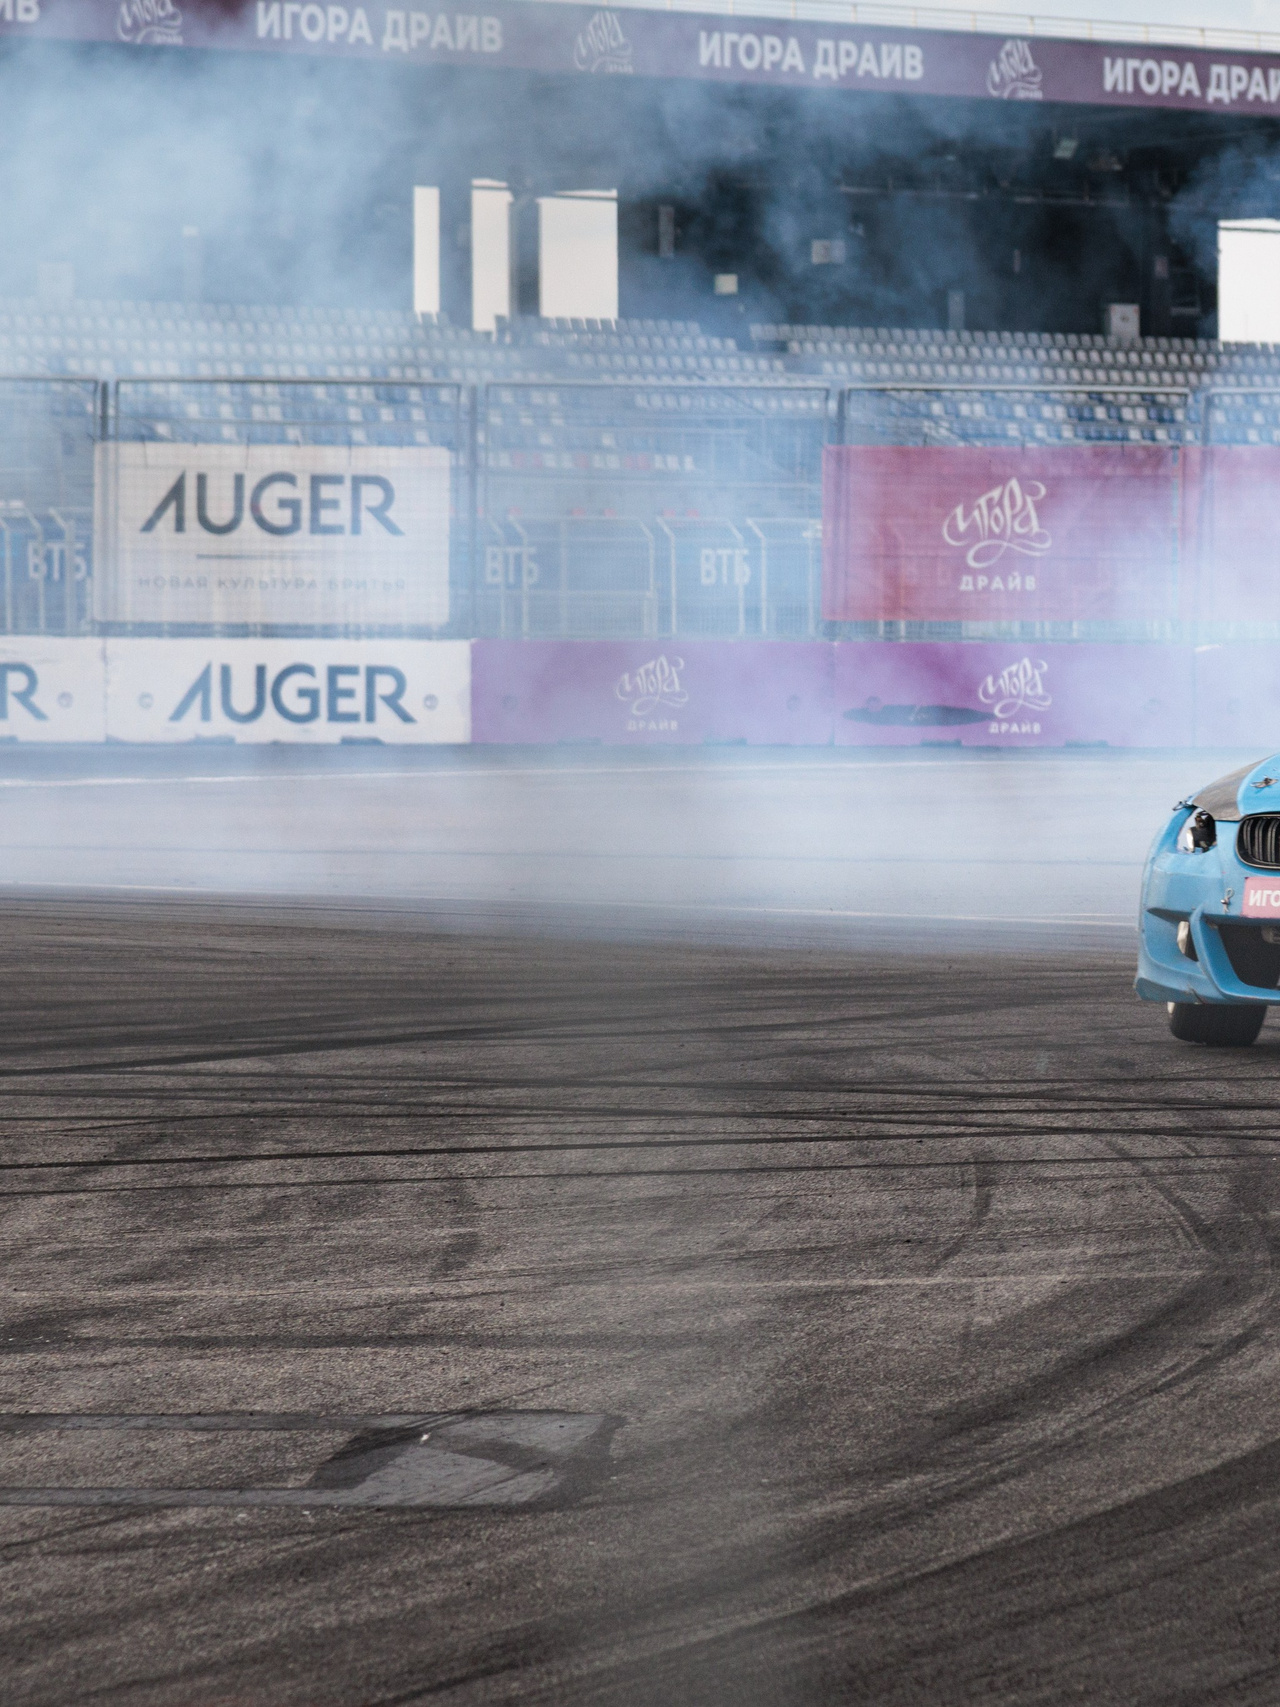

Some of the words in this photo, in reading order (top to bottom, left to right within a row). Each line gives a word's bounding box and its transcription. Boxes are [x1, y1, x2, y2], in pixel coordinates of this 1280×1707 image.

[257, 1, 373, 45] ИГОРА
[699, 30, 805, 74] ИГОРА
[1103, 57, 1201, 97] ИГОРА
[139, 468, 405, 536] AUGER
[28, 542, 87, 580] ВТБ
[485, 546, 540, 585] ВТБ
[701, 548, 752, 586] ВТБ
[960, 571, 1036, 591] ДРАЙВ
[168, 661, 417, 723] AUGER
